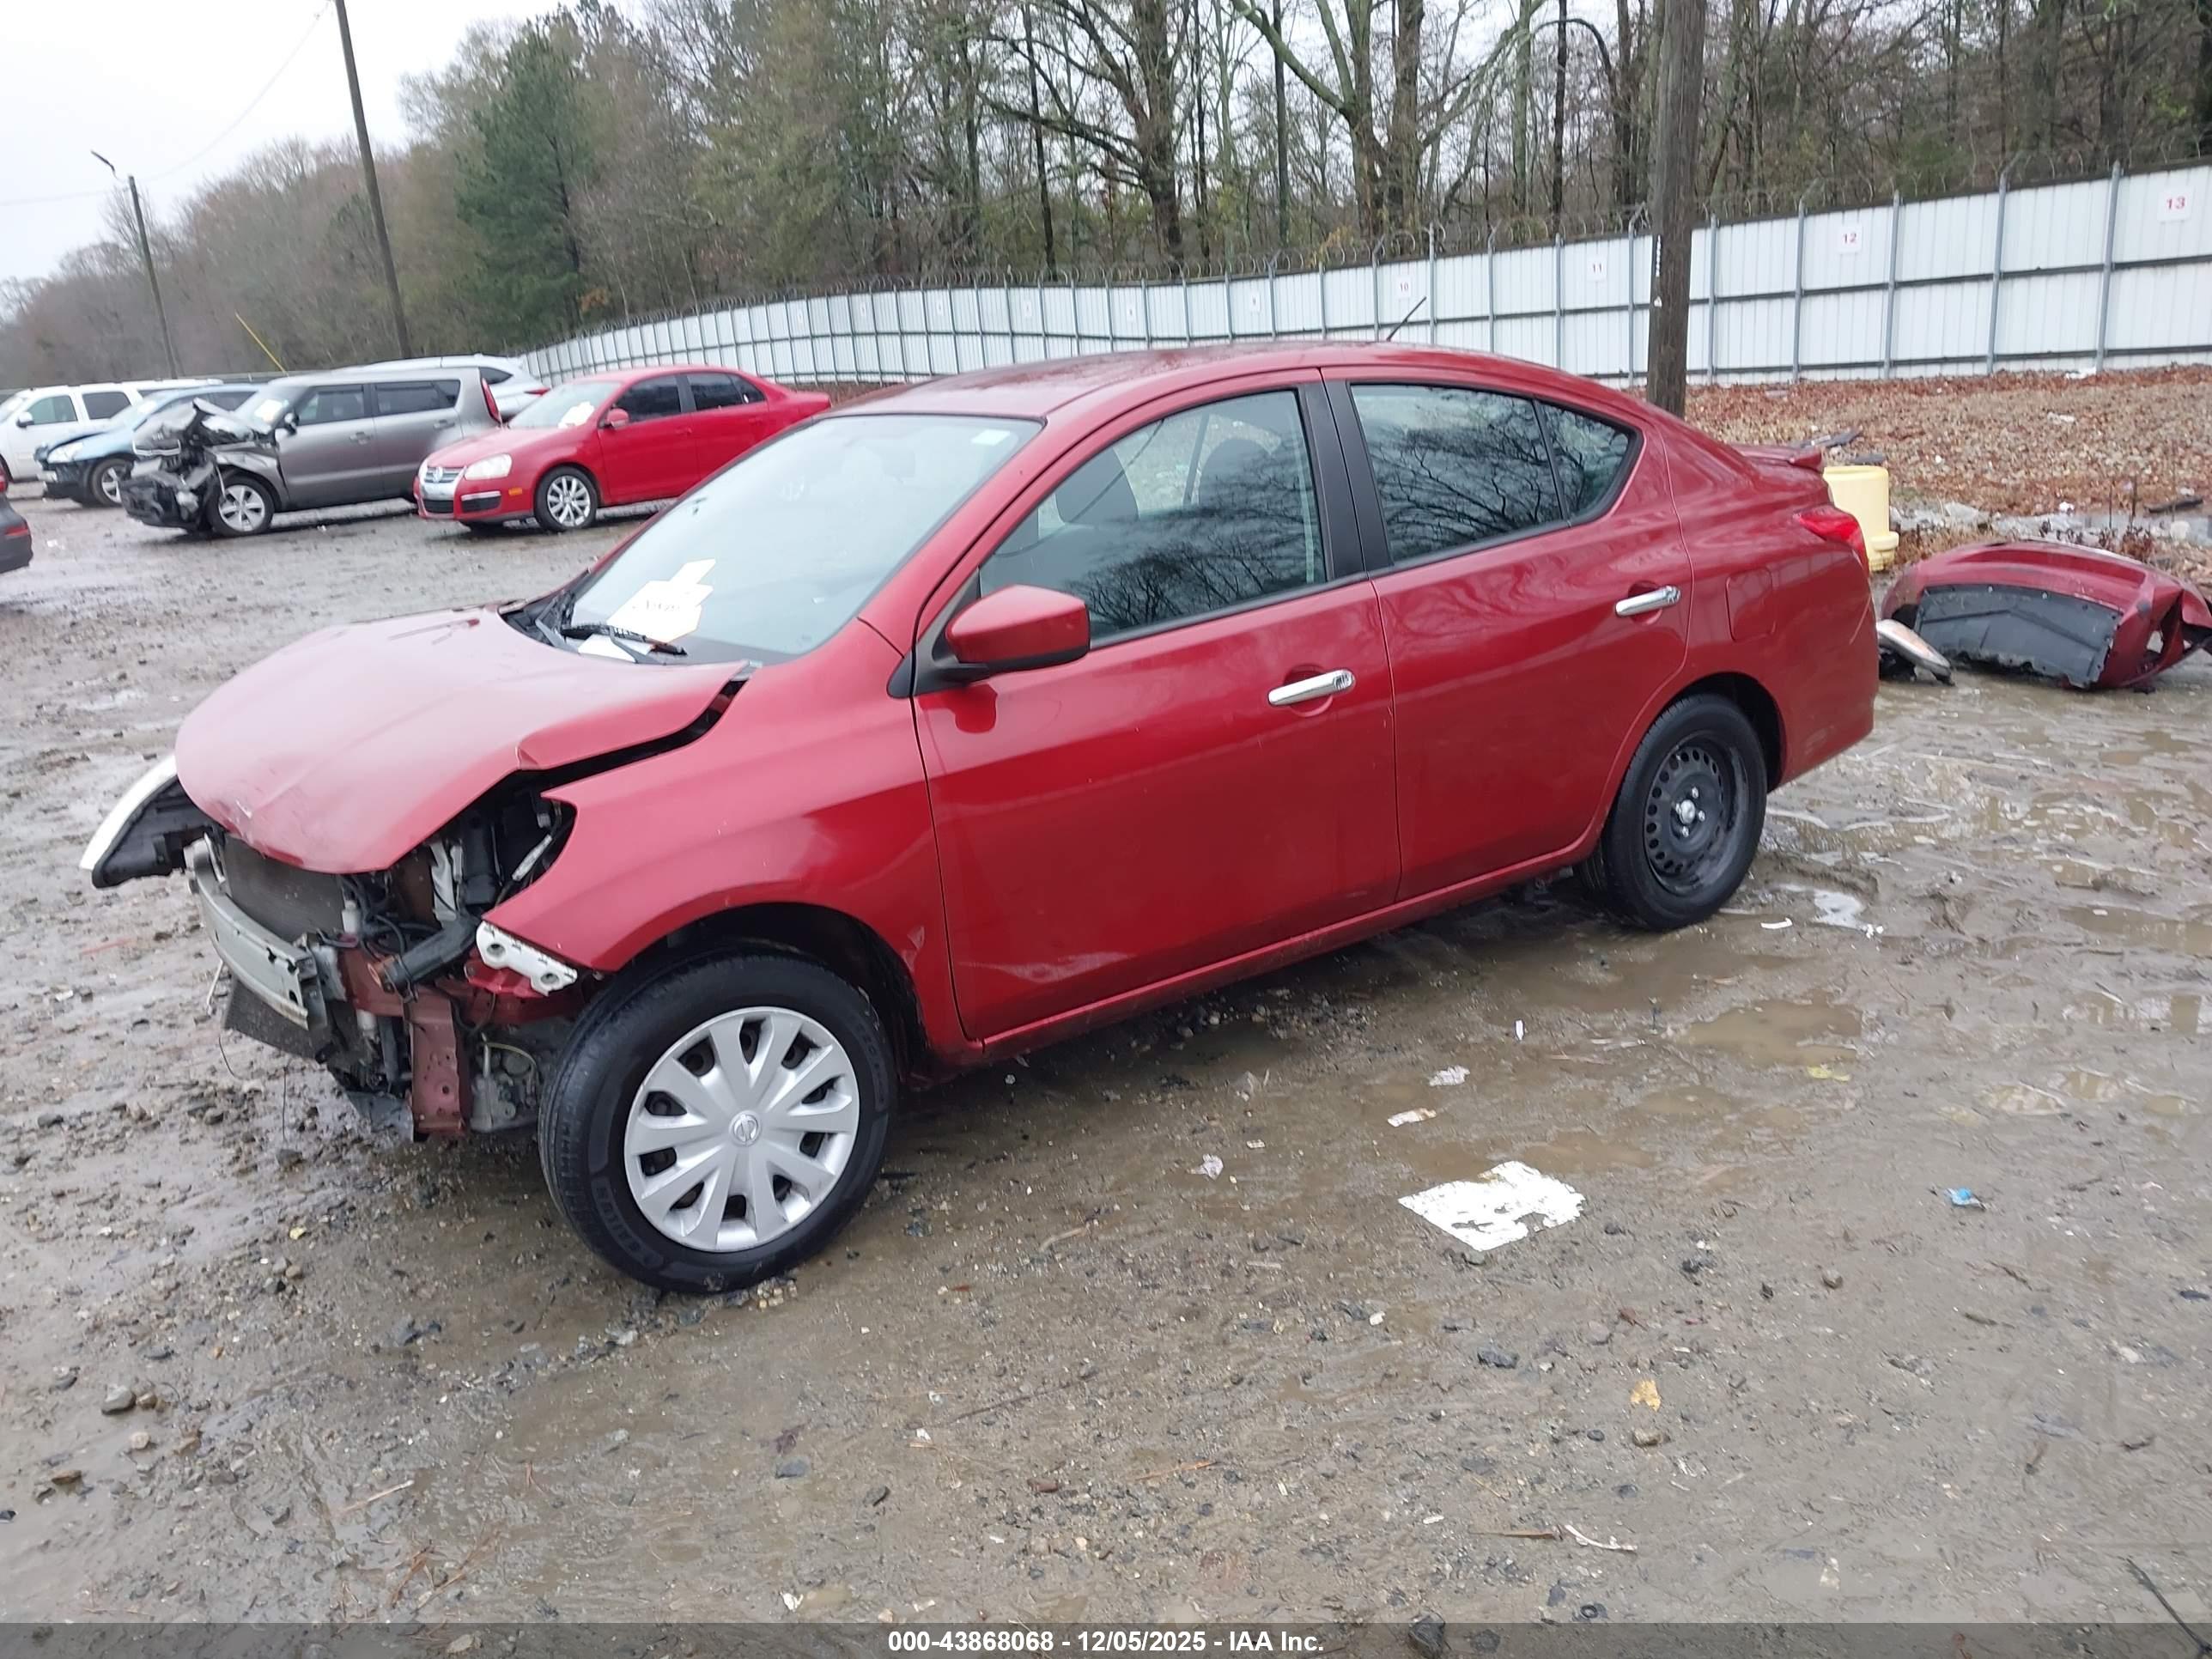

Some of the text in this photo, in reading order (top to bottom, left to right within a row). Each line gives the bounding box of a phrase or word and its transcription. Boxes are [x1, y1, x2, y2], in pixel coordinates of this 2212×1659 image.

[2166, 196, 2186, 210] 13
[1842, 232, 1857, 244] 12
[1591, 263, 1602, 273] 11
